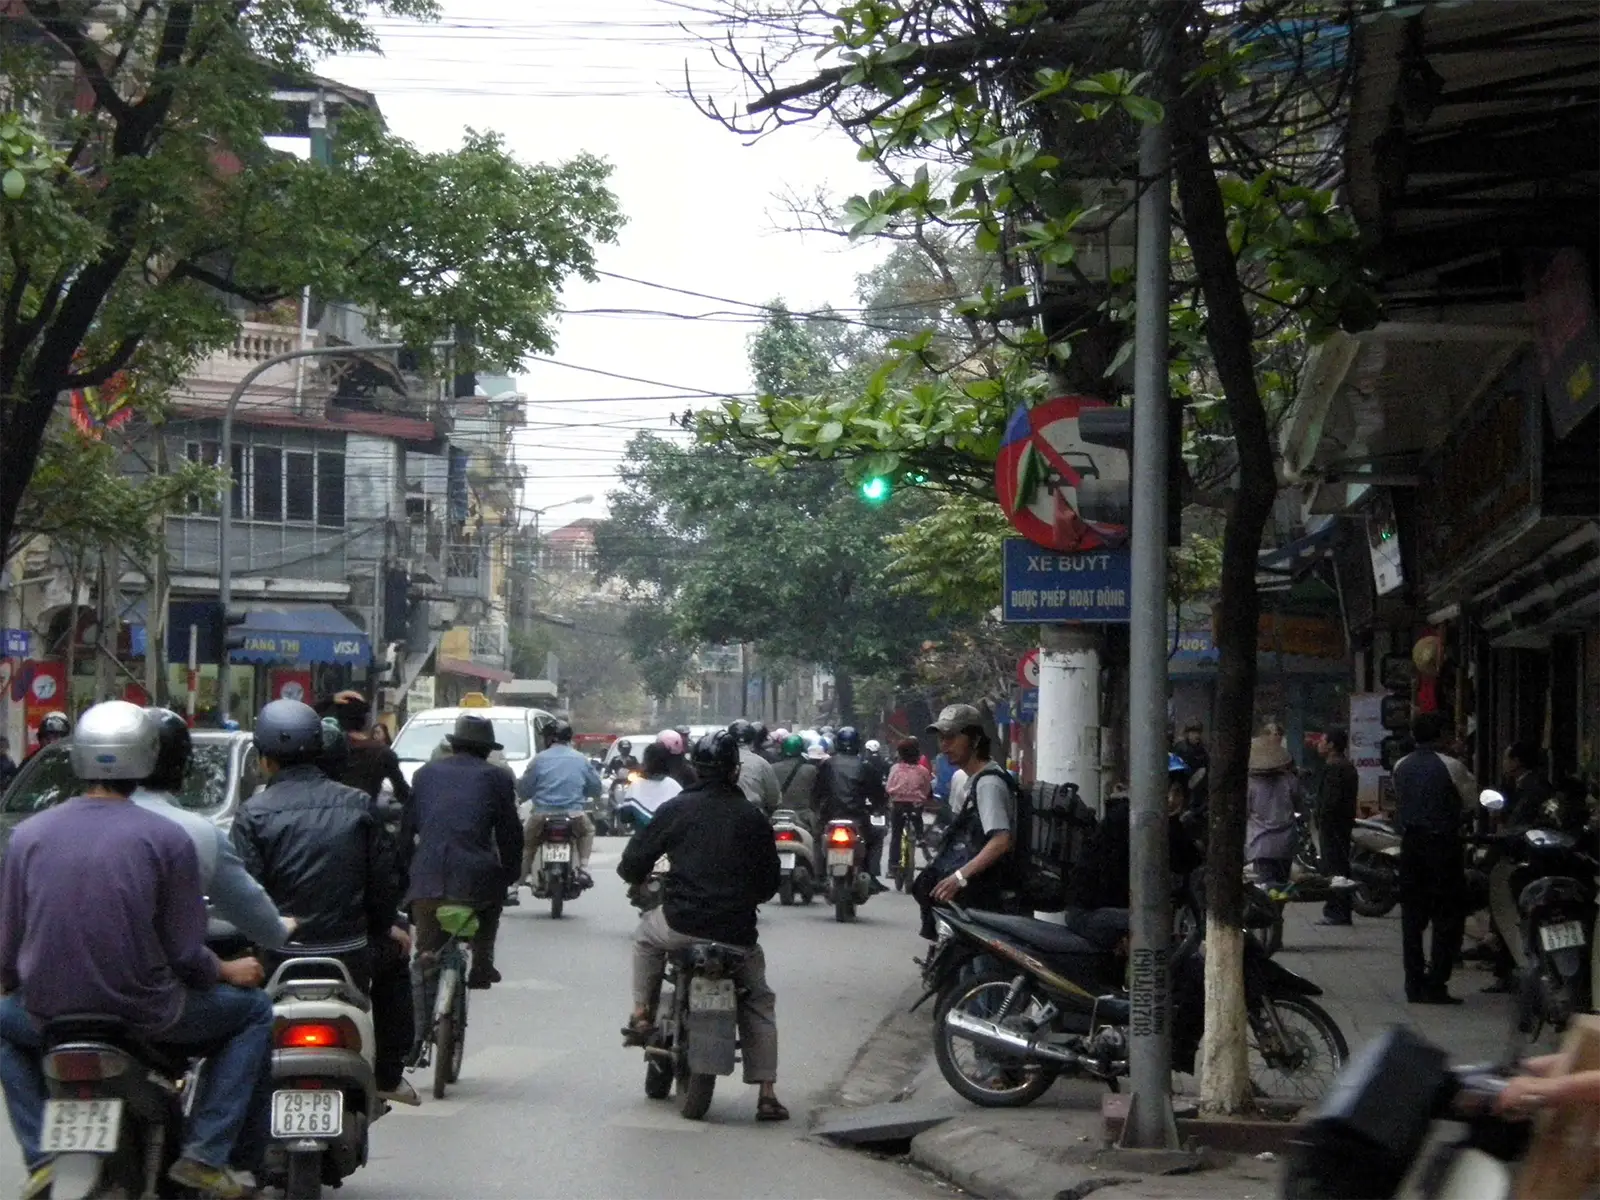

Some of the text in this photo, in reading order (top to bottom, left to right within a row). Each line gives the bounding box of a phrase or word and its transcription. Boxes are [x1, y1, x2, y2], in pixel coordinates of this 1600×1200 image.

[1027, 555, 1053, 572] XE
[333, 641, 360, 654] VISA
[284, 1094, 332, 1113] 29-P9
[283, 1112, 332, 1131] 8269
